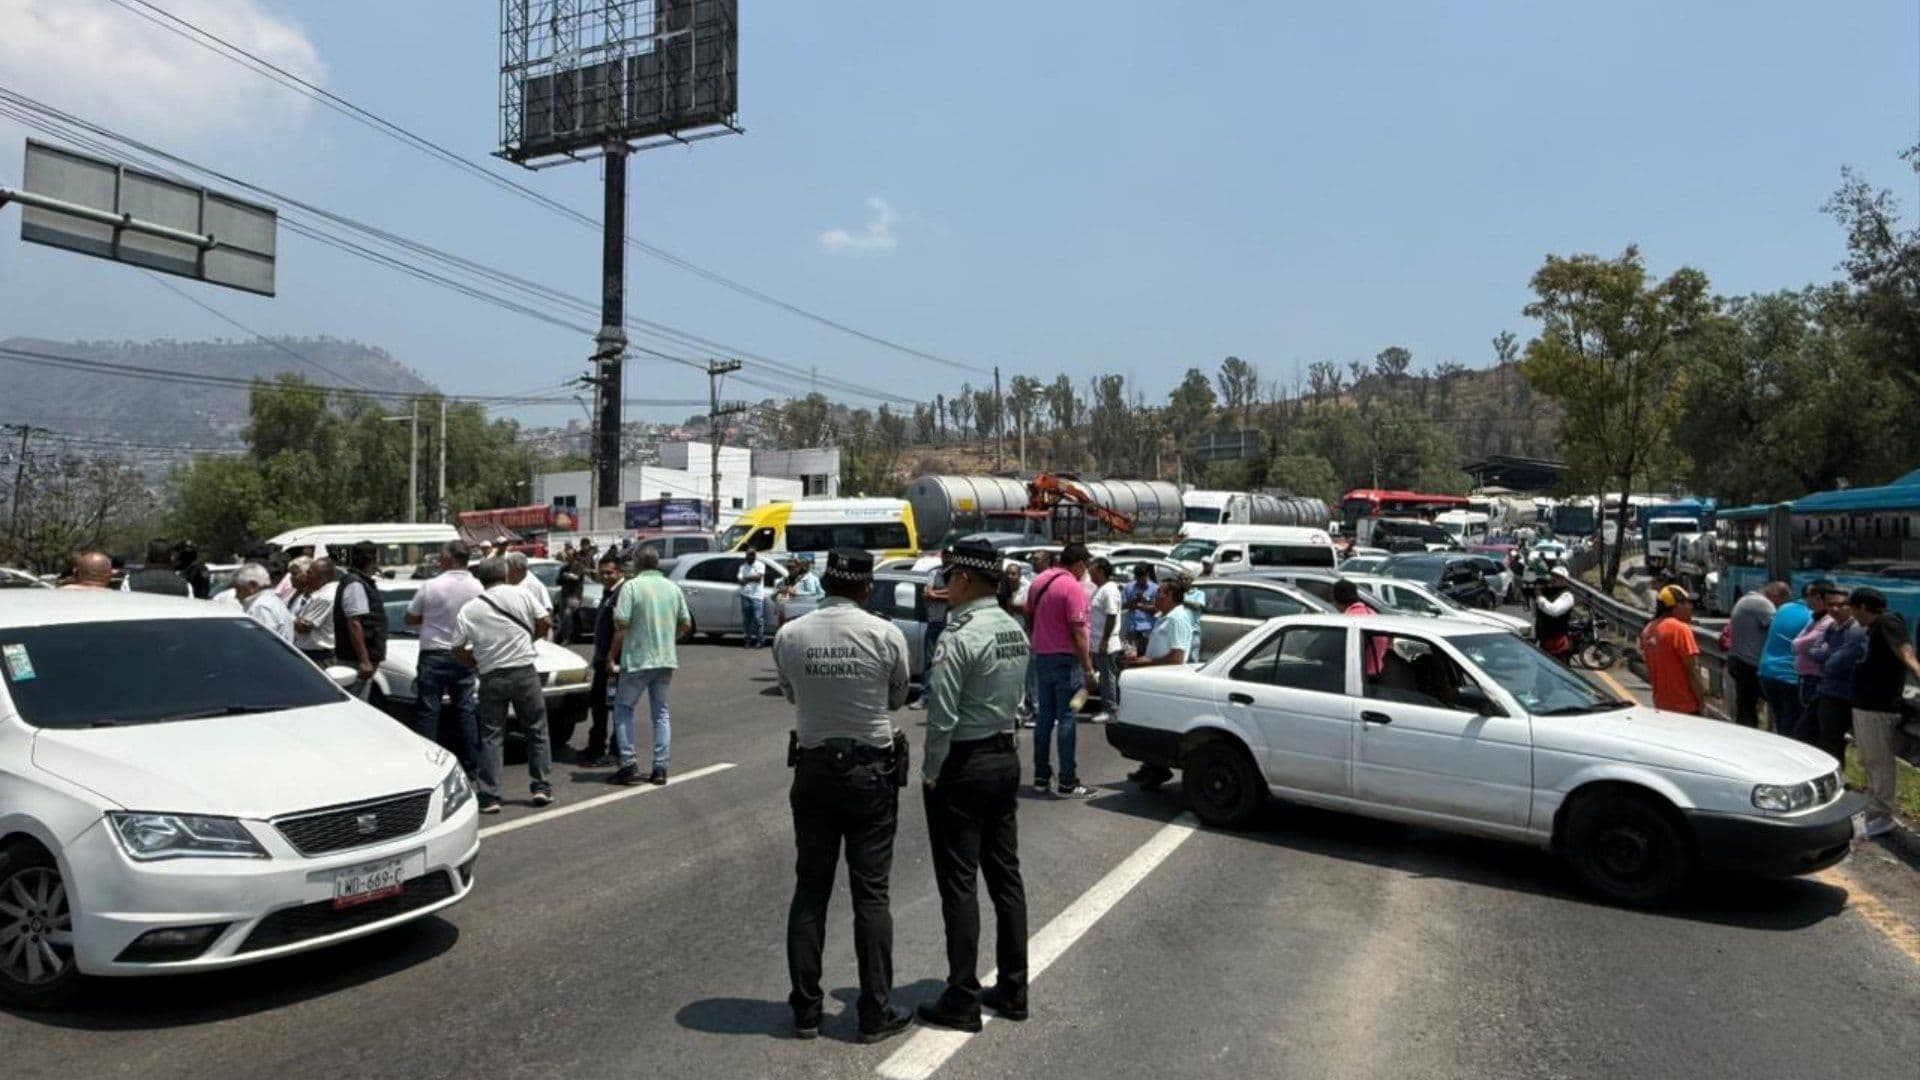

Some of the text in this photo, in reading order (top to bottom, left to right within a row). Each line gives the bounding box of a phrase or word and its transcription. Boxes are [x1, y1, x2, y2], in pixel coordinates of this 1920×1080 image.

[995, 630, 1024, 645] GUARDIA
[806, 646, 857, 659] GUARDIA
[995, 645, 1027, 660] NACIONAL
[805, 662, 861, 676] NACIONAL
